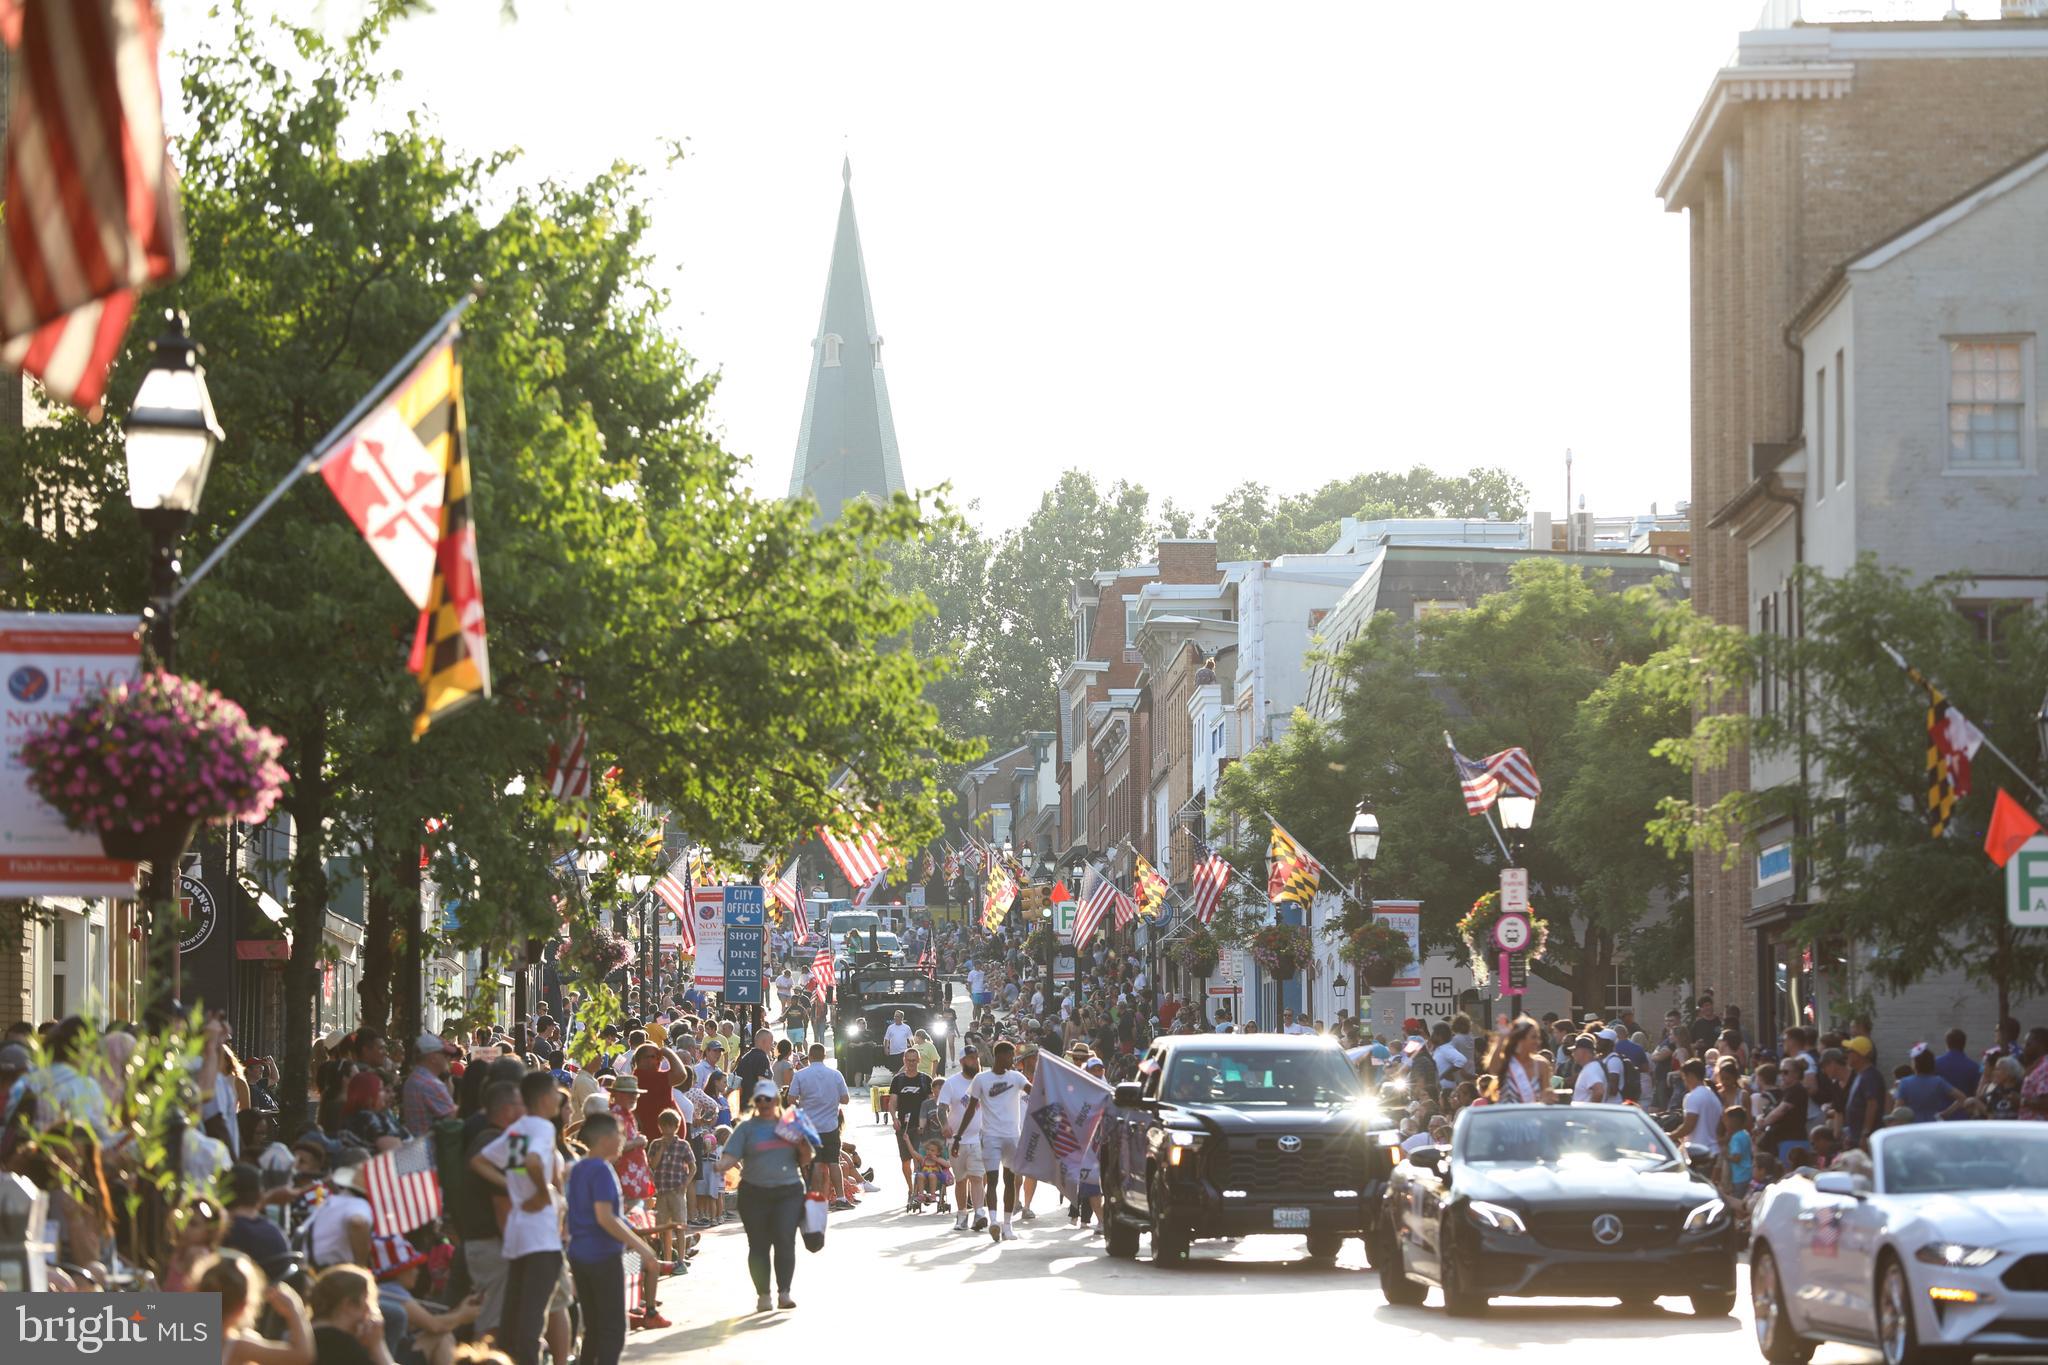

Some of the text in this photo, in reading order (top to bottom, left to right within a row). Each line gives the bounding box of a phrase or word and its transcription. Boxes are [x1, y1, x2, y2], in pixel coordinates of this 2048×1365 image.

[180, 879, 211, 913] OHN'S
[734, 889, 753, 900] CITY
[727, 902, 761, 914] OFFICES
[729, 931, 759, 941] SHOP
[730, 950, 757, 959] DINE
[729, 968, 757, 977] ARTS
[1411, 1003, 1453, 1016] TRUI
